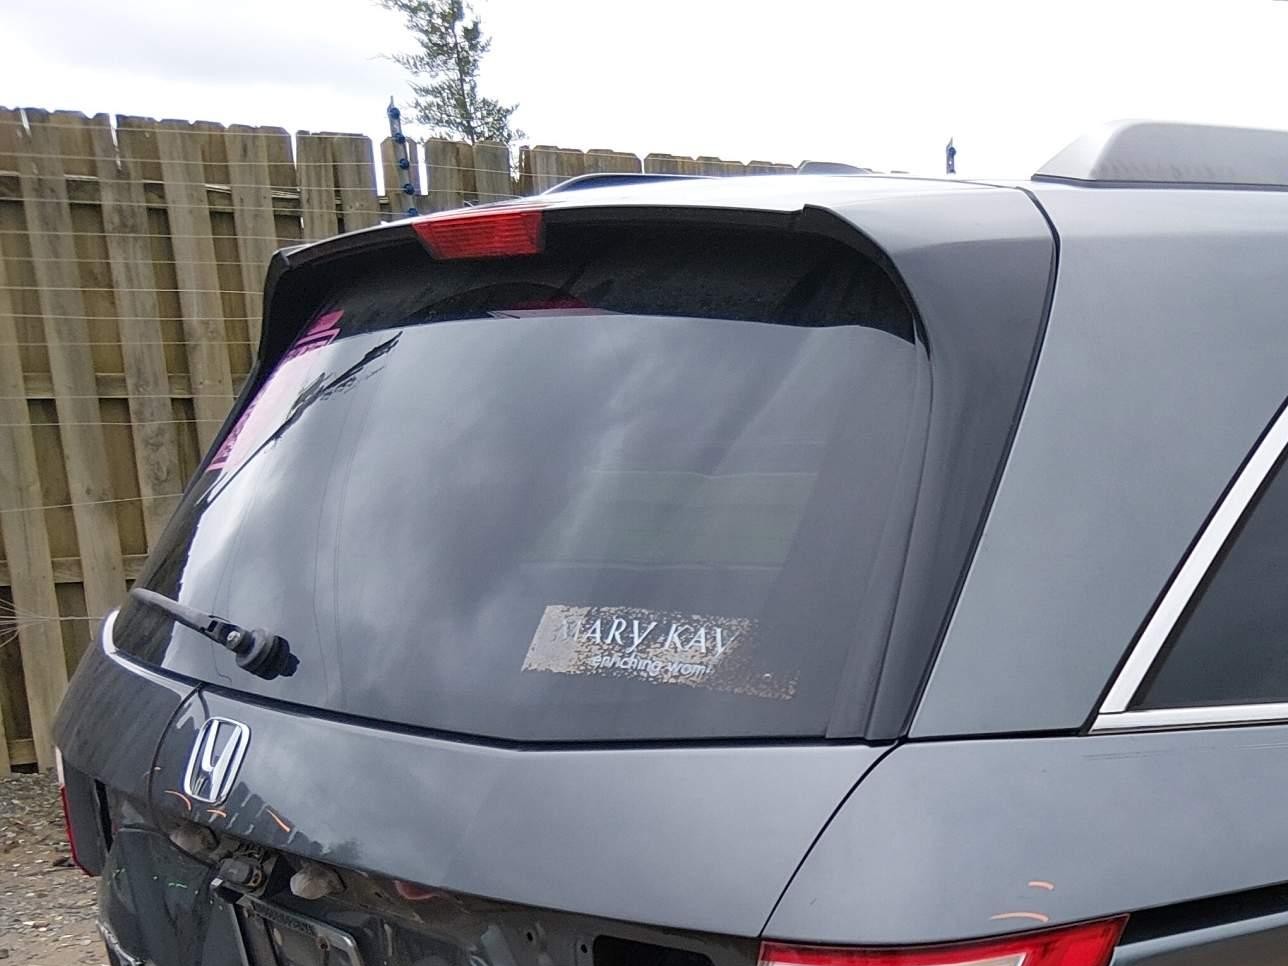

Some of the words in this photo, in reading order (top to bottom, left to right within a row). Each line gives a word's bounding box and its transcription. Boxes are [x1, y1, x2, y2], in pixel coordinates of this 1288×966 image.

[554, 618, 658, 653] MARY
[661, 622, 741, 659] KAY
[592, 651, 661, 677] enriching
